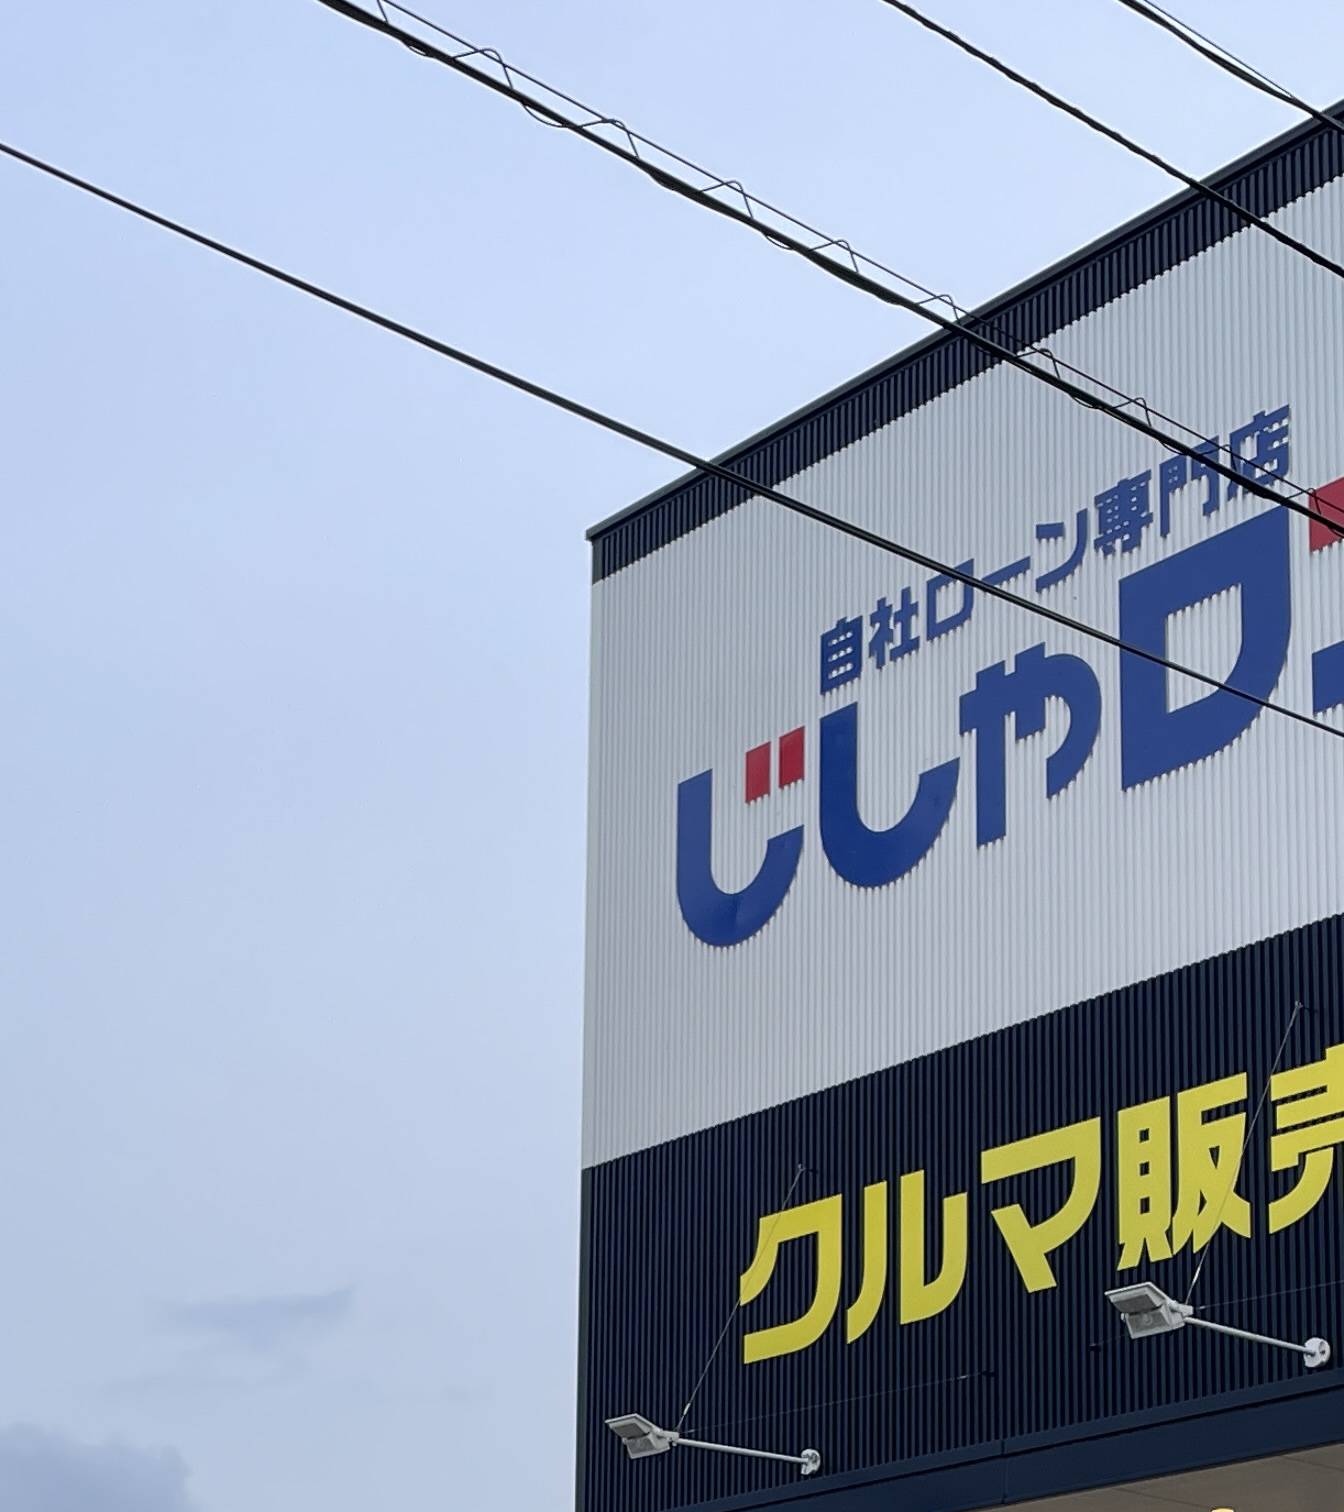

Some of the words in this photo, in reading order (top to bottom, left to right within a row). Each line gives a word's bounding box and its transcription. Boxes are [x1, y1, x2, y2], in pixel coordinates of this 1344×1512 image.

[820, 404, 1293, 695] 自社ローン専門店
